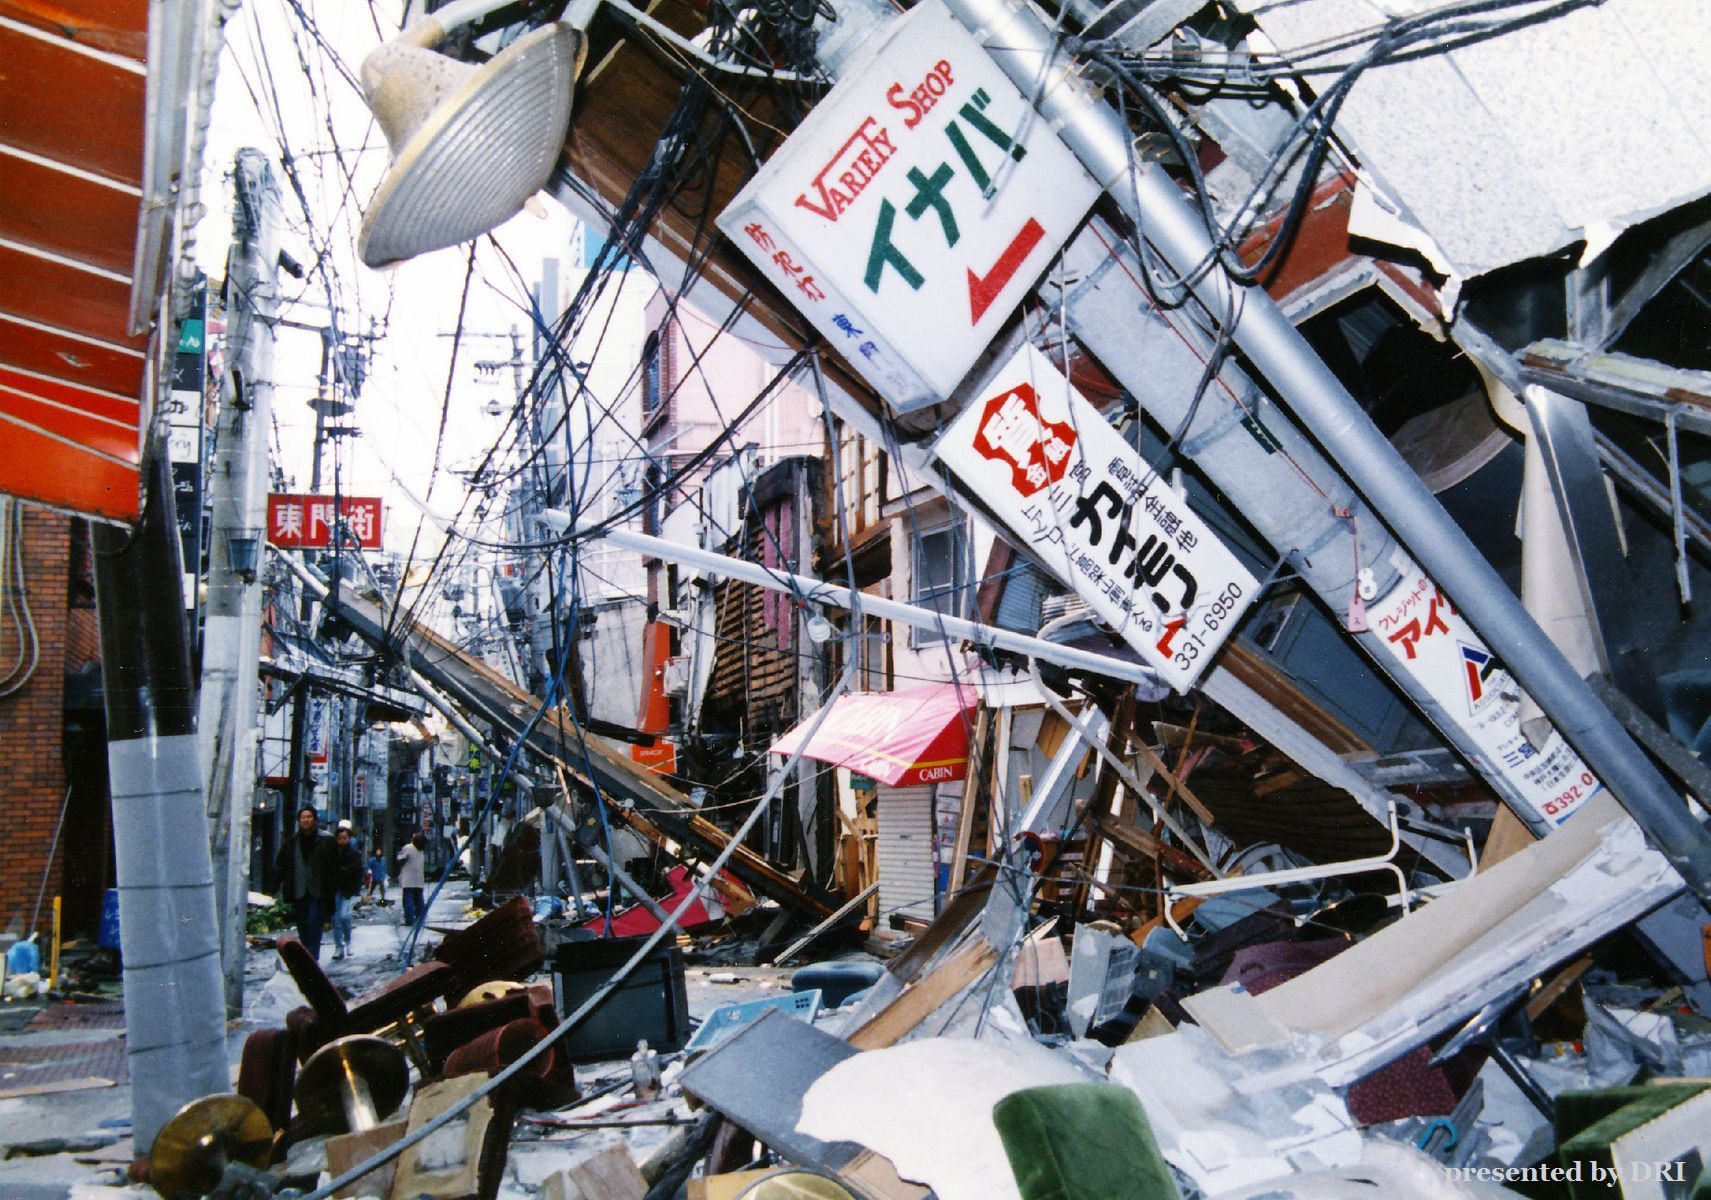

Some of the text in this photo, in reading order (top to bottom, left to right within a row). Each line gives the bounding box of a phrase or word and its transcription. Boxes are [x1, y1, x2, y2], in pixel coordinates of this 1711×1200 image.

[795, 60, 954, 222] VARIETY SHOP
[864, 87, 1027, 294] イナバ
[982, 393, 1053, 469] 質
[1026, 435, 1072, 489] 金融
[1048, 458, 1093, 513] 三宮
[1070, 480, 1198, 613] カイモリ
[1175, 582, 1242, 671] 331-6950
[1379, 574, 1430, 631] クレジットの
[919, 766, 953, 781] CABIN
